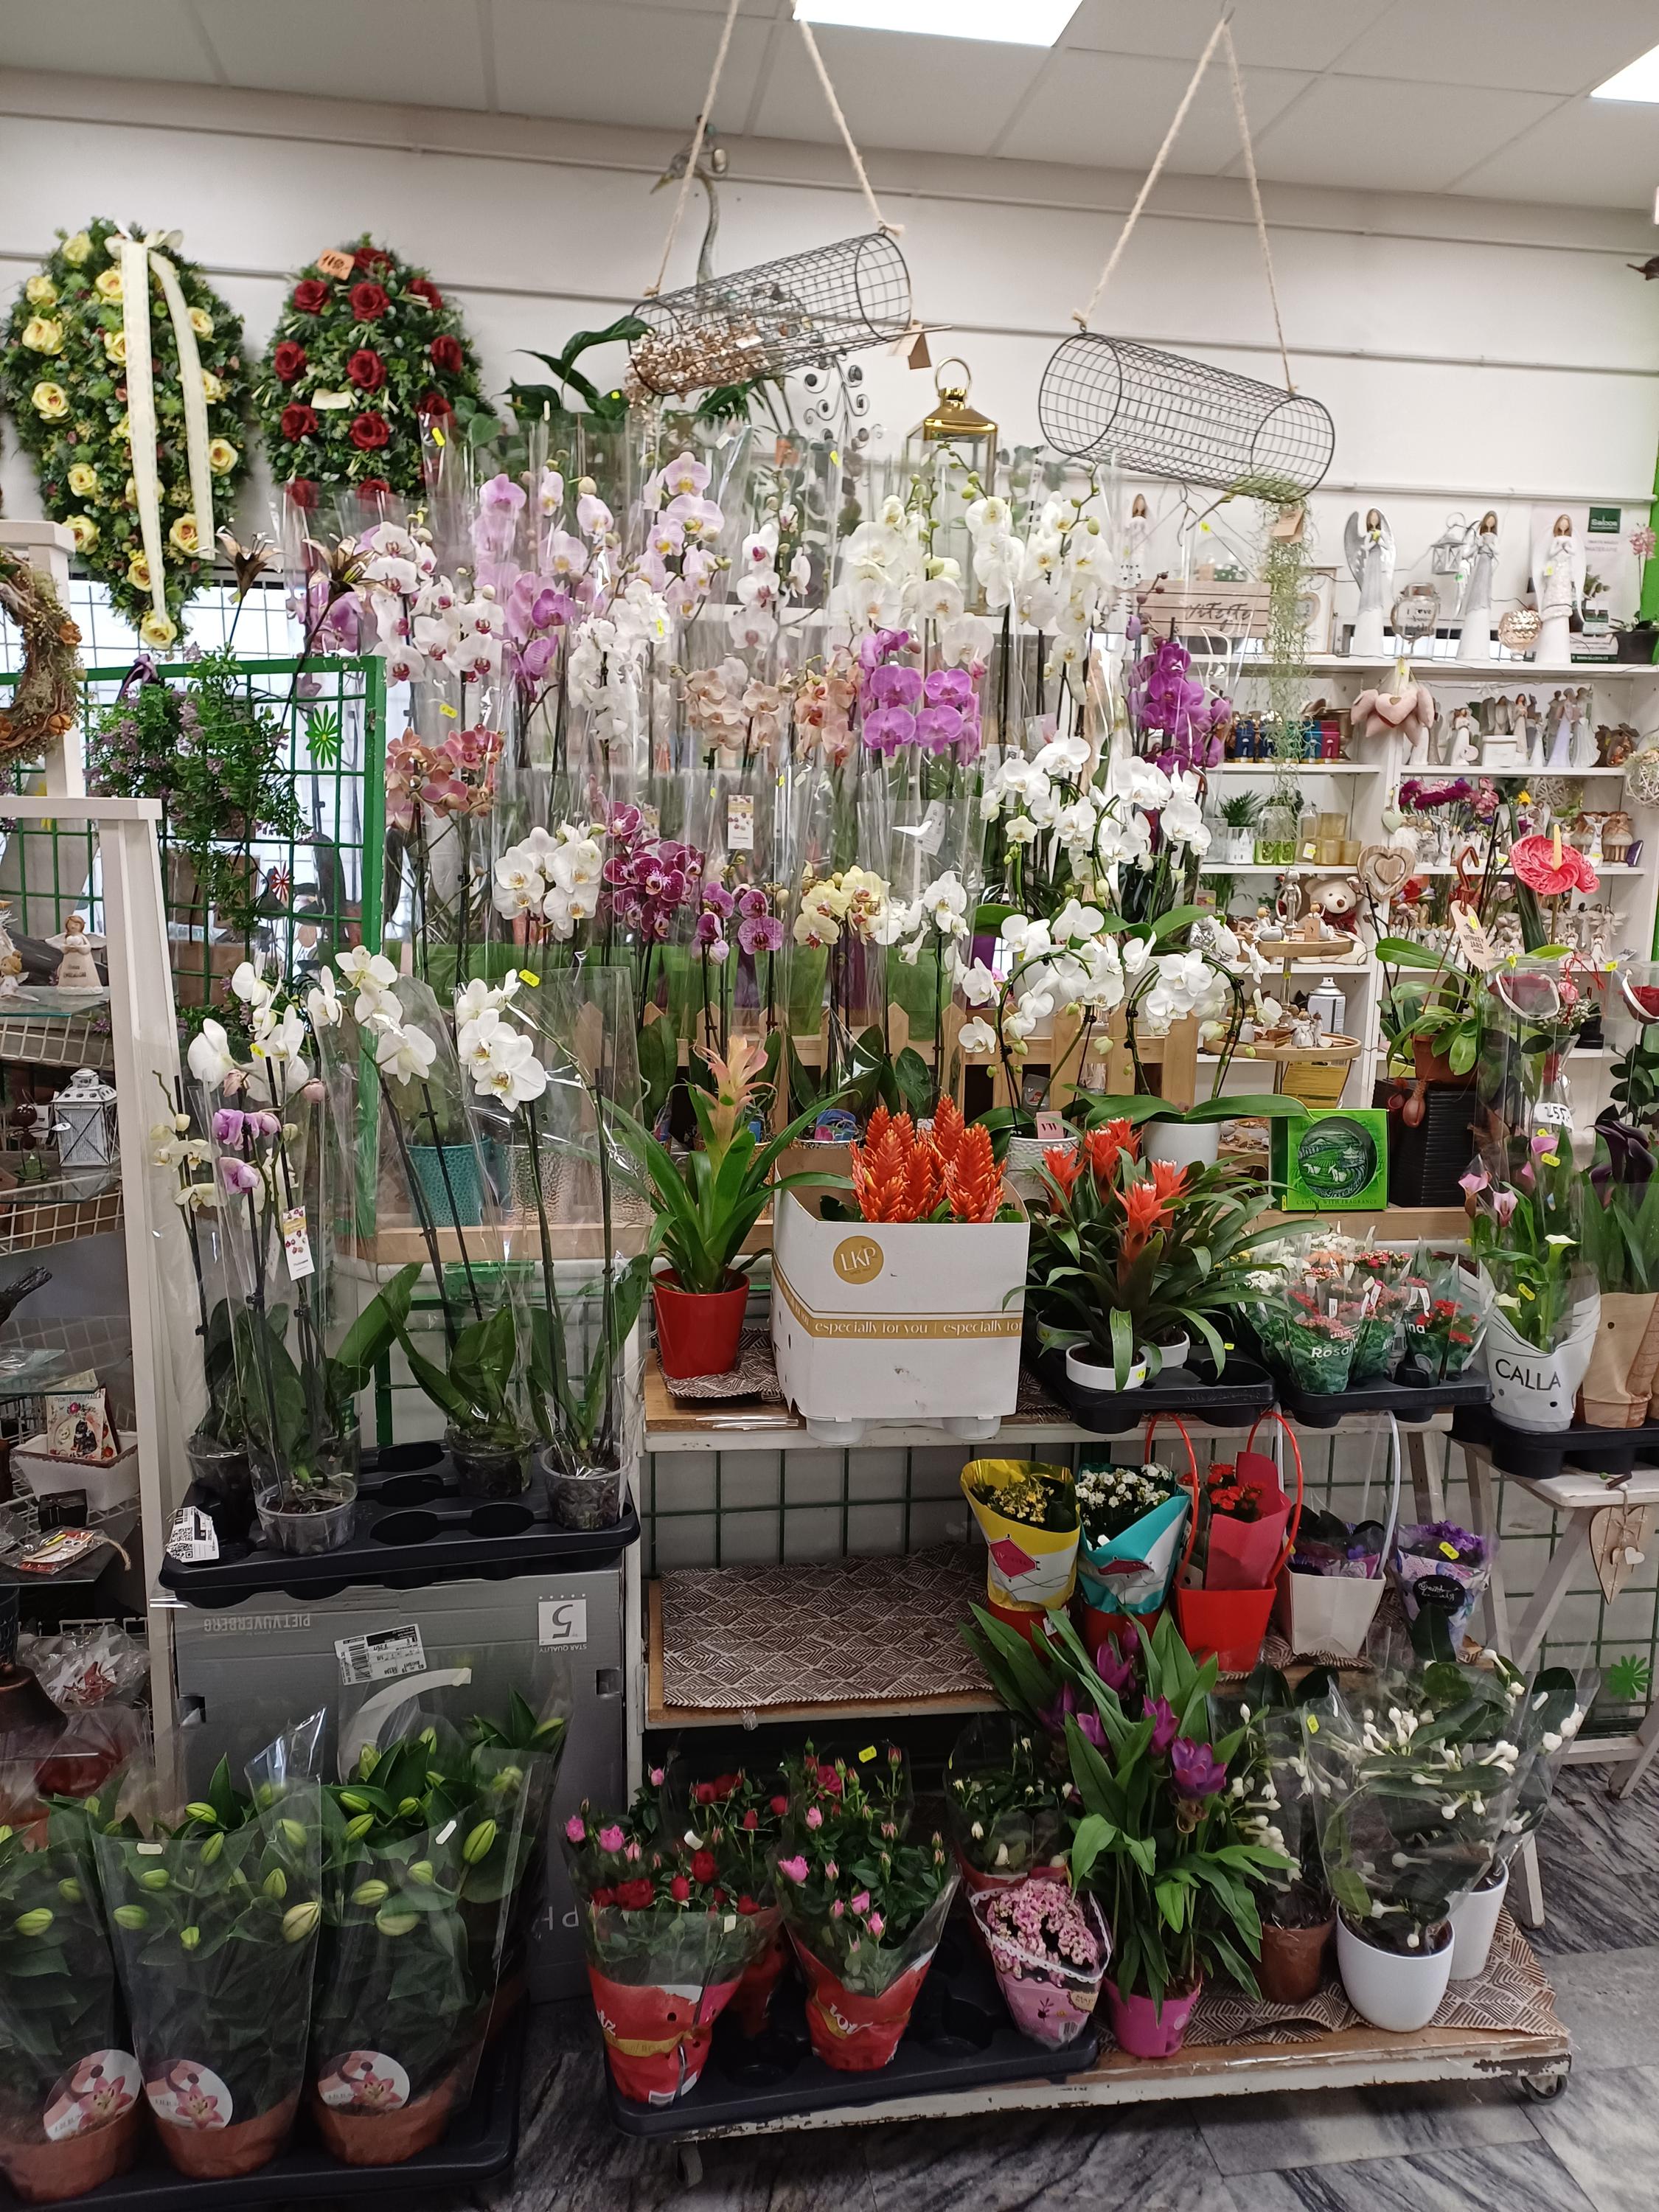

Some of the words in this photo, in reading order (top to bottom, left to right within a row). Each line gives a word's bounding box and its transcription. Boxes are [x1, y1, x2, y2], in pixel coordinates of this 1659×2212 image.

[841, 1247, 876, 1271] LKP
[815, 1321, 877, 1335] especially
[883, 1321, 900, 1334] for
[904, 1321, 928, 1335] you
[943, 1319, 1002, 1336] especially
[1495, 1358, 1561, 1391] CALLA
[552, 1604, 573, 1638] 5
[539, 1644, 569, 1653] QUALITY
